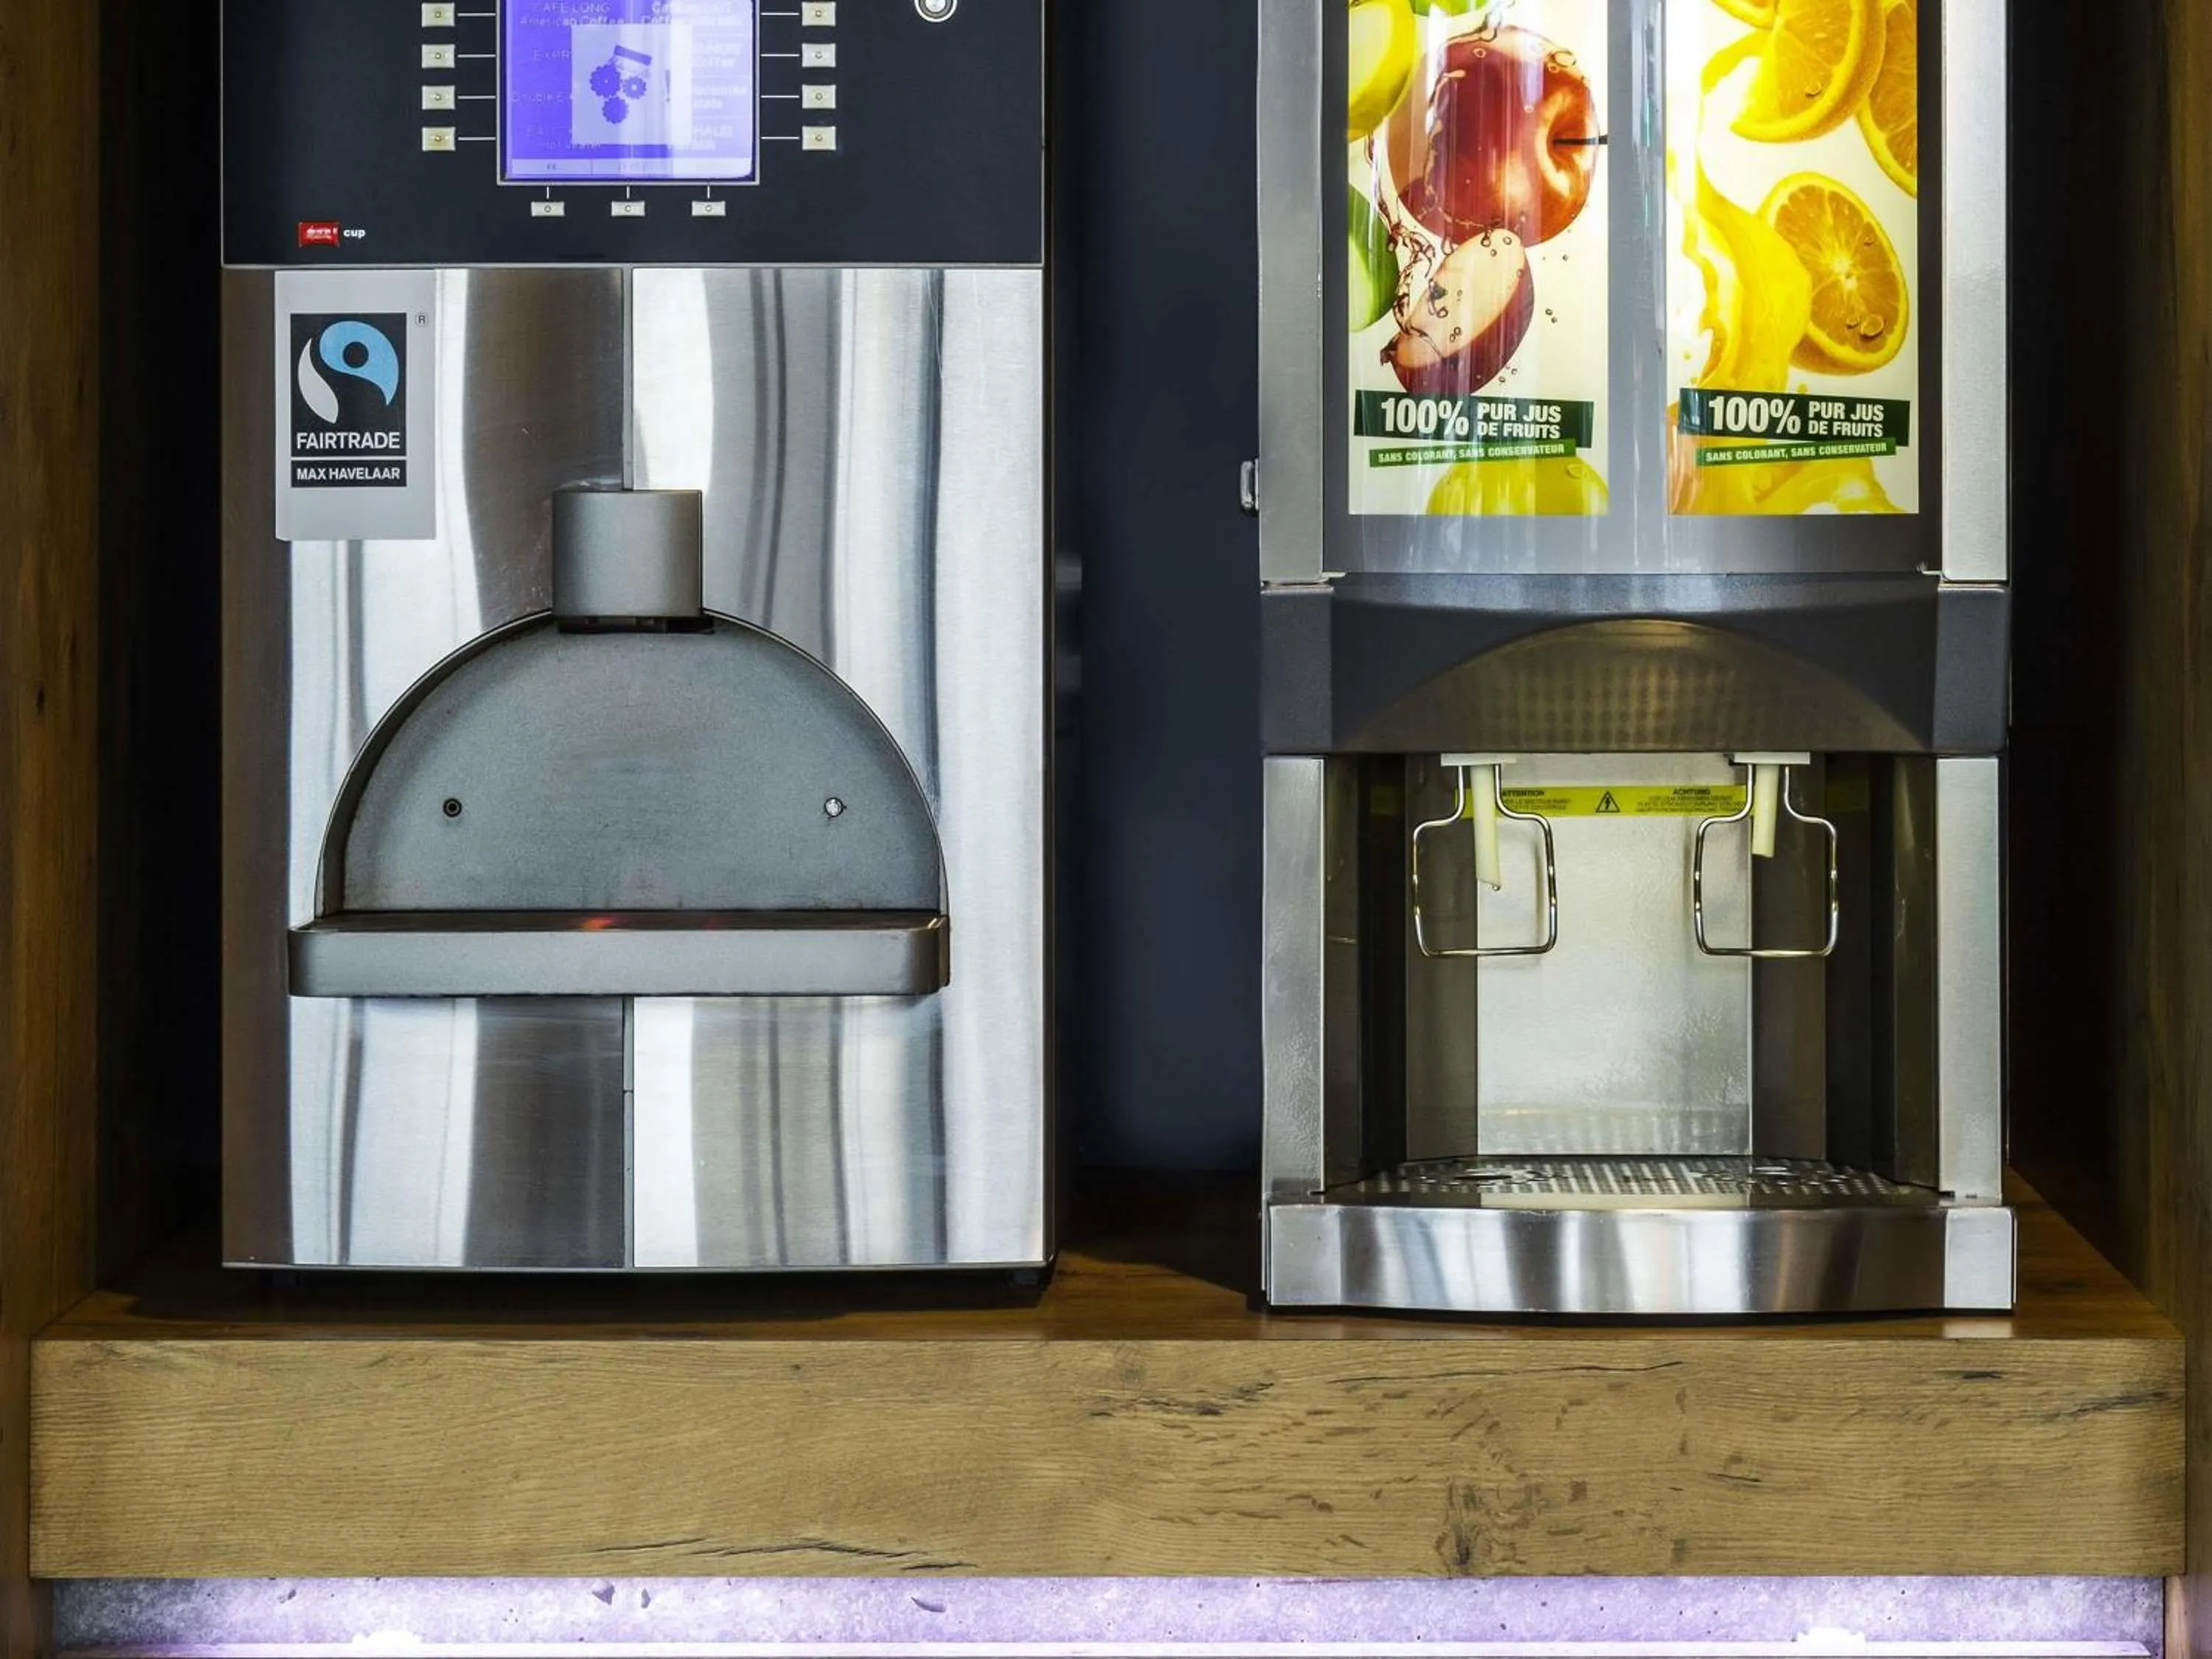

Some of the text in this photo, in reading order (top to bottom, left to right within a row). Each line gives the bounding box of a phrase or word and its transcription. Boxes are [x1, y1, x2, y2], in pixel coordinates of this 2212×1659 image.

[343, 229, 366, 239] cup
[1381, 398, 1562, 437] 100% PUR JUS
[1709, 396, 1884, 434] 100% PUR JUS
[1478, 421, 1561, 439] DE FRUITS
[1808, 420, 1884, 437] DE FRUITS
[296, 431, 401, 449] FAIRTRADE
[1378, 443, 1565, 463] SANS COLORANT, SANS CONSERVATEUR
[1705, 442, 1887, 462] SANS COLORANT, SANS CONSERVATEUR
[297, 467, 401, 480] MAX HAVELAAR
